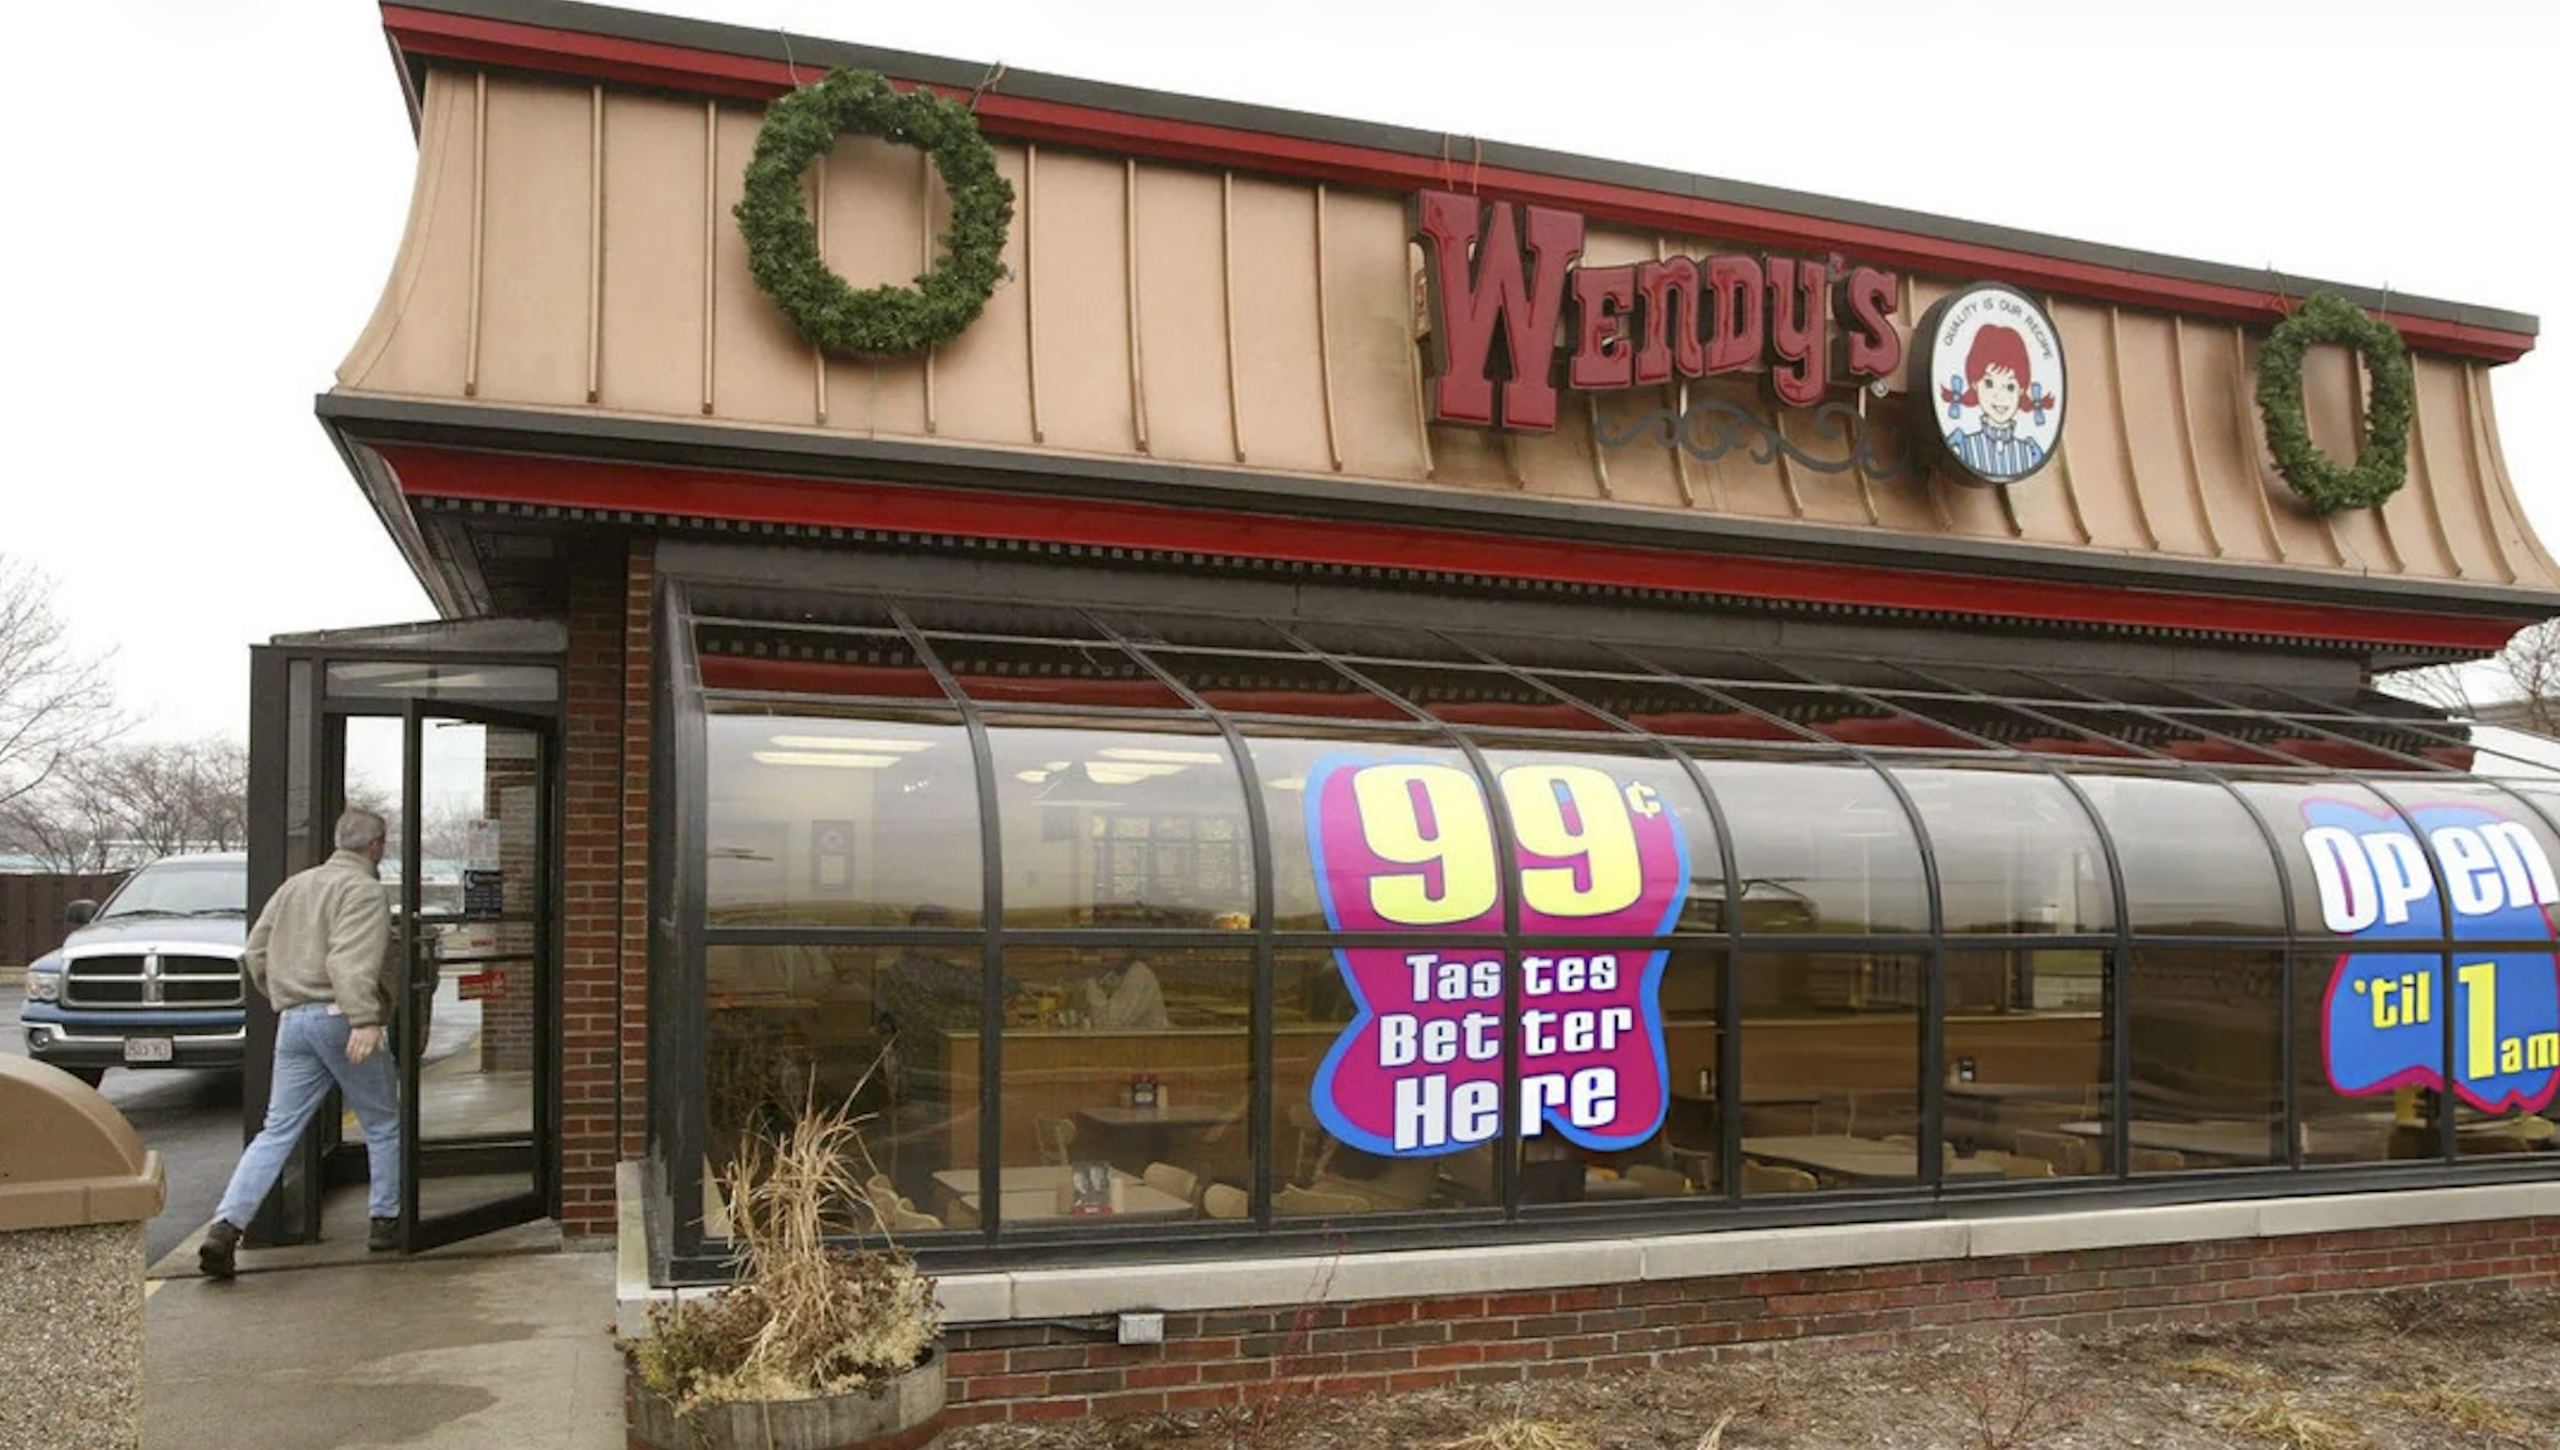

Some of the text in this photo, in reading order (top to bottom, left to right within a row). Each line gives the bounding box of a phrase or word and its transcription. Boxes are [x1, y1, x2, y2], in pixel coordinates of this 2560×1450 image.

[1943, 298, 2053, 360] QUALITY IS OUR RECIPE
[2302, 821, 2560, 933] Open
[1406, 954, 1617, 1002] Tastes
[1379, 1006, 1632, 1066] Better
[1394, 1066, 1616, 1150] Here
